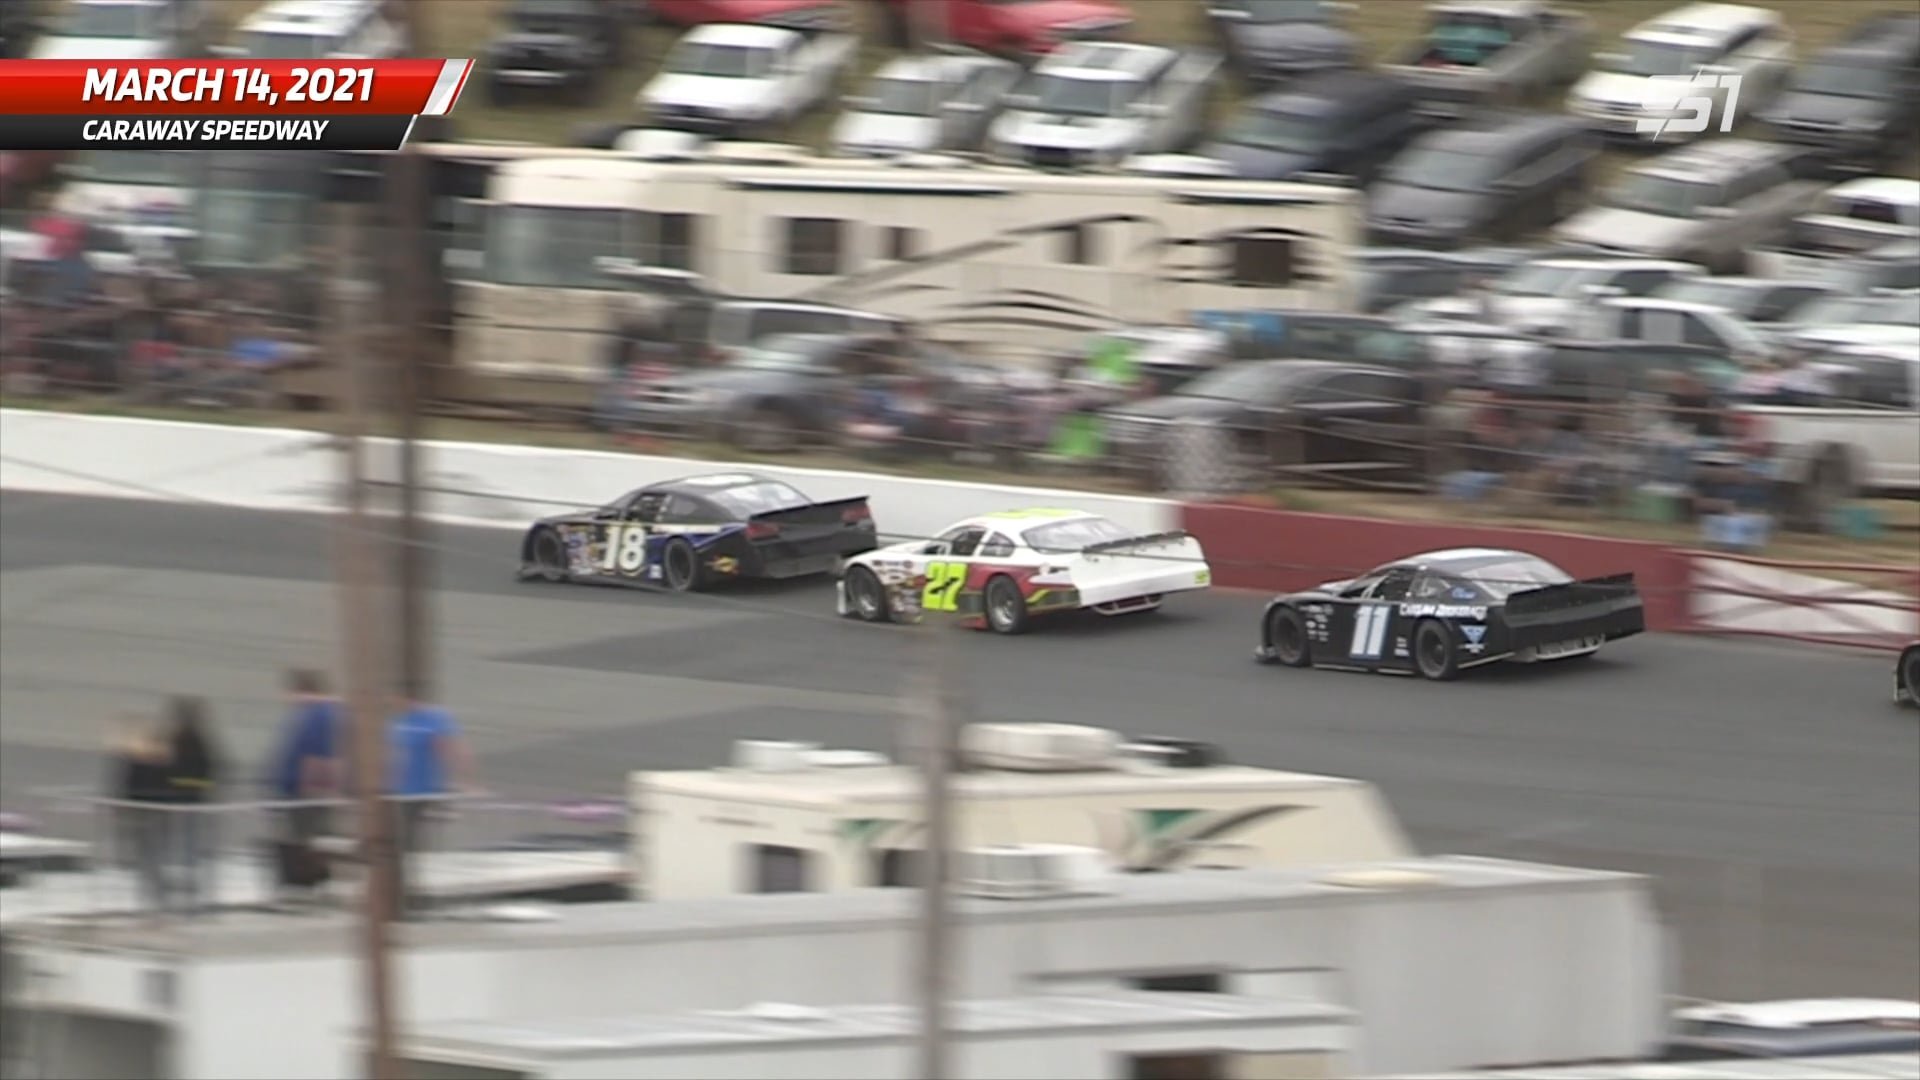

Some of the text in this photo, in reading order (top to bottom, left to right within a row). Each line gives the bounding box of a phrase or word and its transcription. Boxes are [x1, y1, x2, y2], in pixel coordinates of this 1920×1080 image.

[602, 523, 647, 575] 18
[922, 561, 968, 612] 27
[1350, 604, 1392, 660] 11
